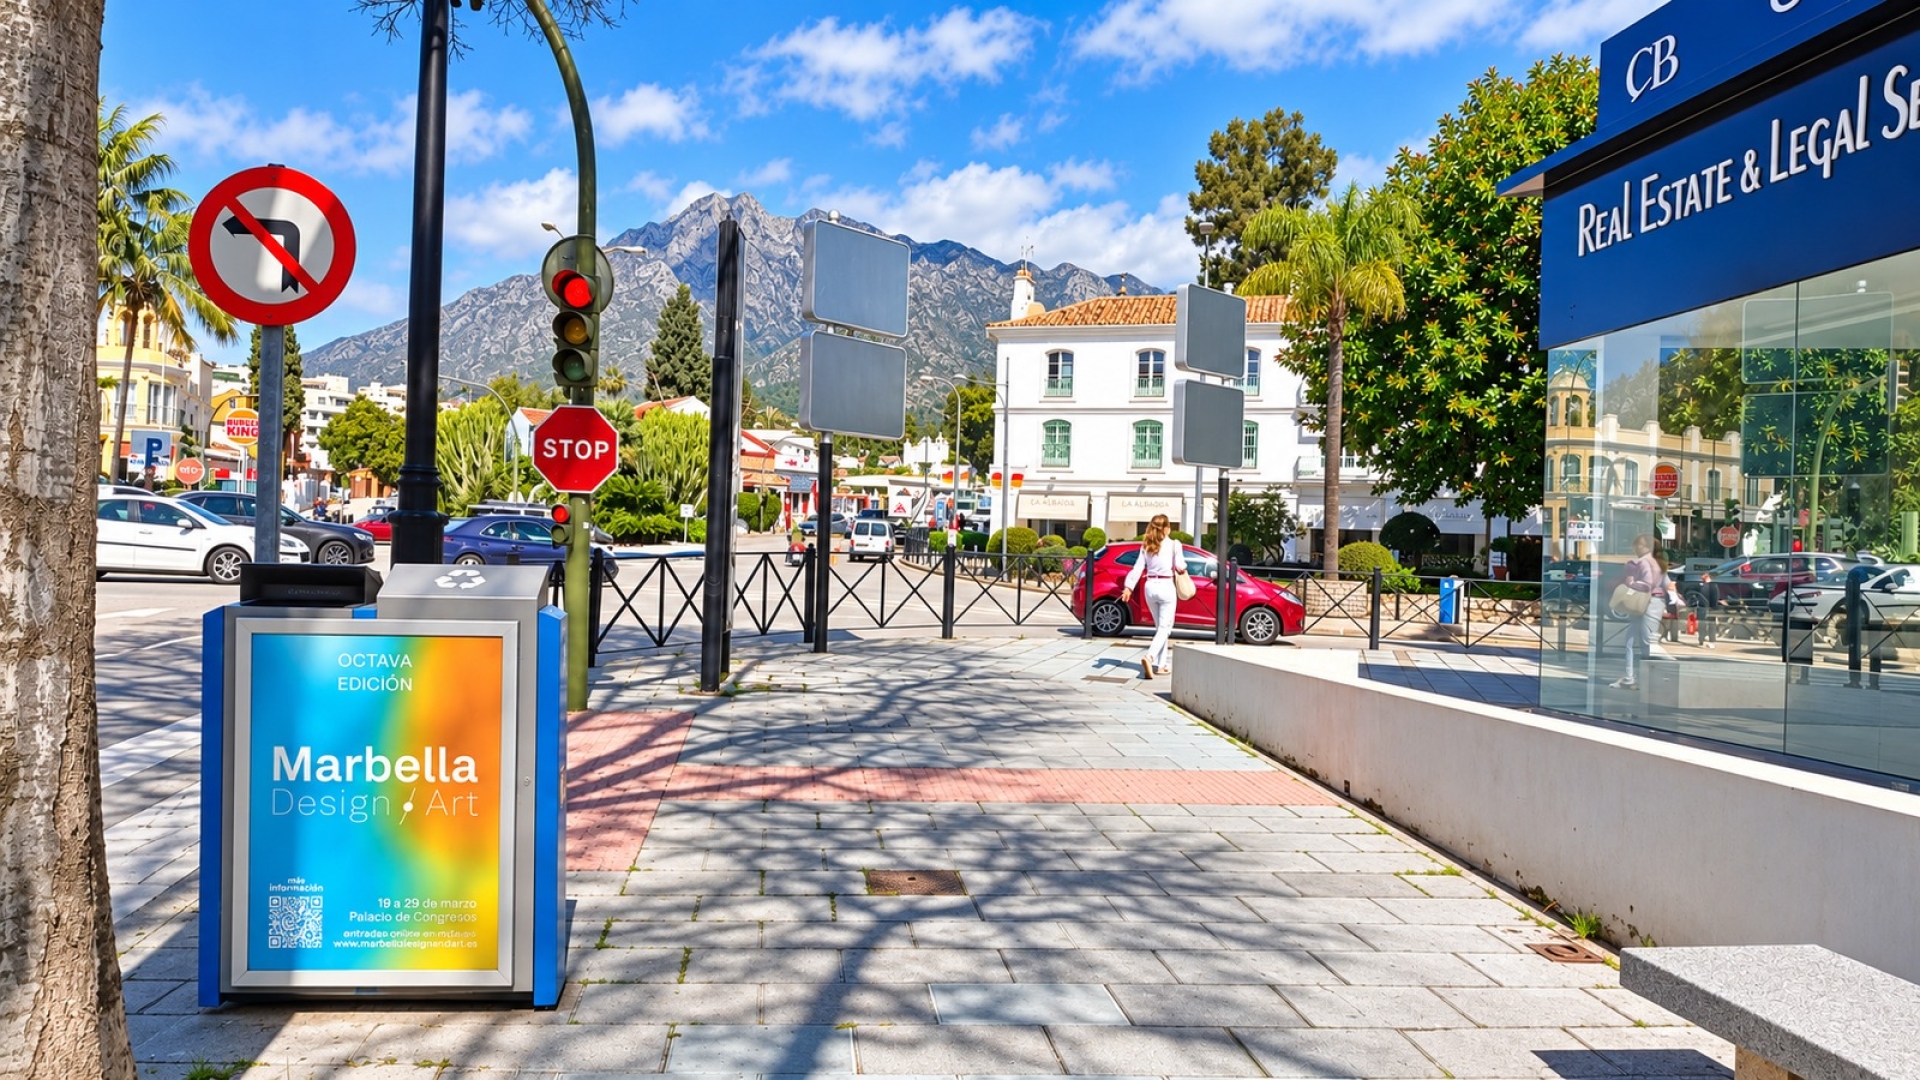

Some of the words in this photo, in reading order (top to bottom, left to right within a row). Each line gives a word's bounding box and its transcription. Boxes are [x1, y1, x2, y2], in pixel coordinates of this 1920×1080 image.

[1740, 149, 1762, 194] &
[227, 426, 259, 437] KING
[542, 438, 610, 460] STOP
[337, 653, 413, 668] OCTAVA
[337, 673, 413, 691] EDICIÓN
[273, 745, 479, 783] Marbella
[271, 788, 391, 823] Design
[425, 789, 479, 817] Art
[393, 900, 401, 908] a
[404, 898, 420, 908] 29
[422, 898, 438, 908] de
[440, 900, 477, 909] marzo
[349, 911, 392, 921] Palacio
[395, 911, 411, 921] de
[413, 911, 478, 924] Congresos
